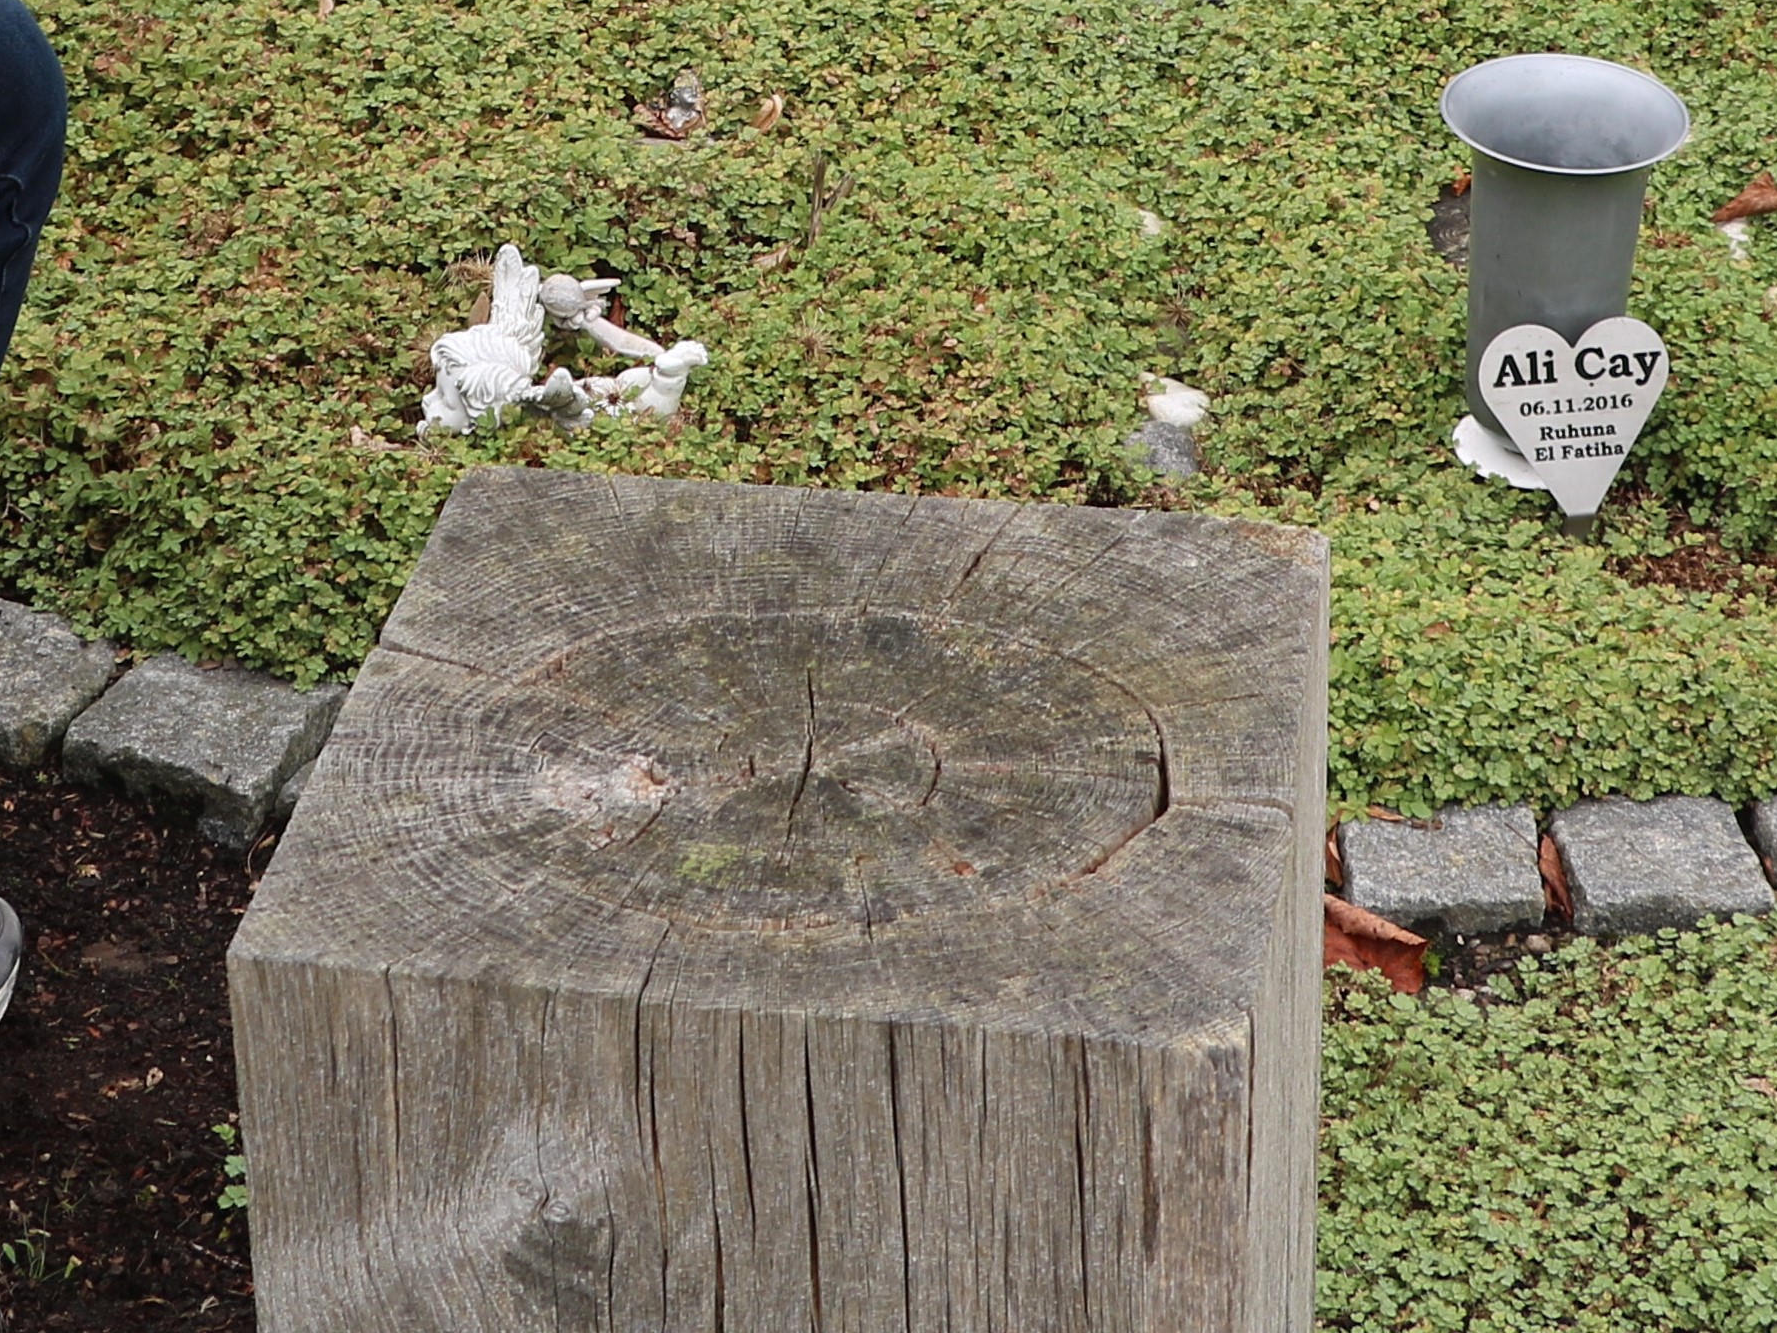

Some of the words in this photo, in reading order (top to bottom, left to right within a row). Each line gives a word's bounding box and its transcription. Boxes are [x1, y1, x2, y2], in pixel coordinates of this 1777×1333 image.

[1493, 349, 1558, 388] Ali
[1519, 393, 1633, 417] 06.11.2016
[1540, 423, 1616, 440] Ruhuna
[1535, 446, 1554, 462] El
[1561, 441, 1624, 460] Fatiha
